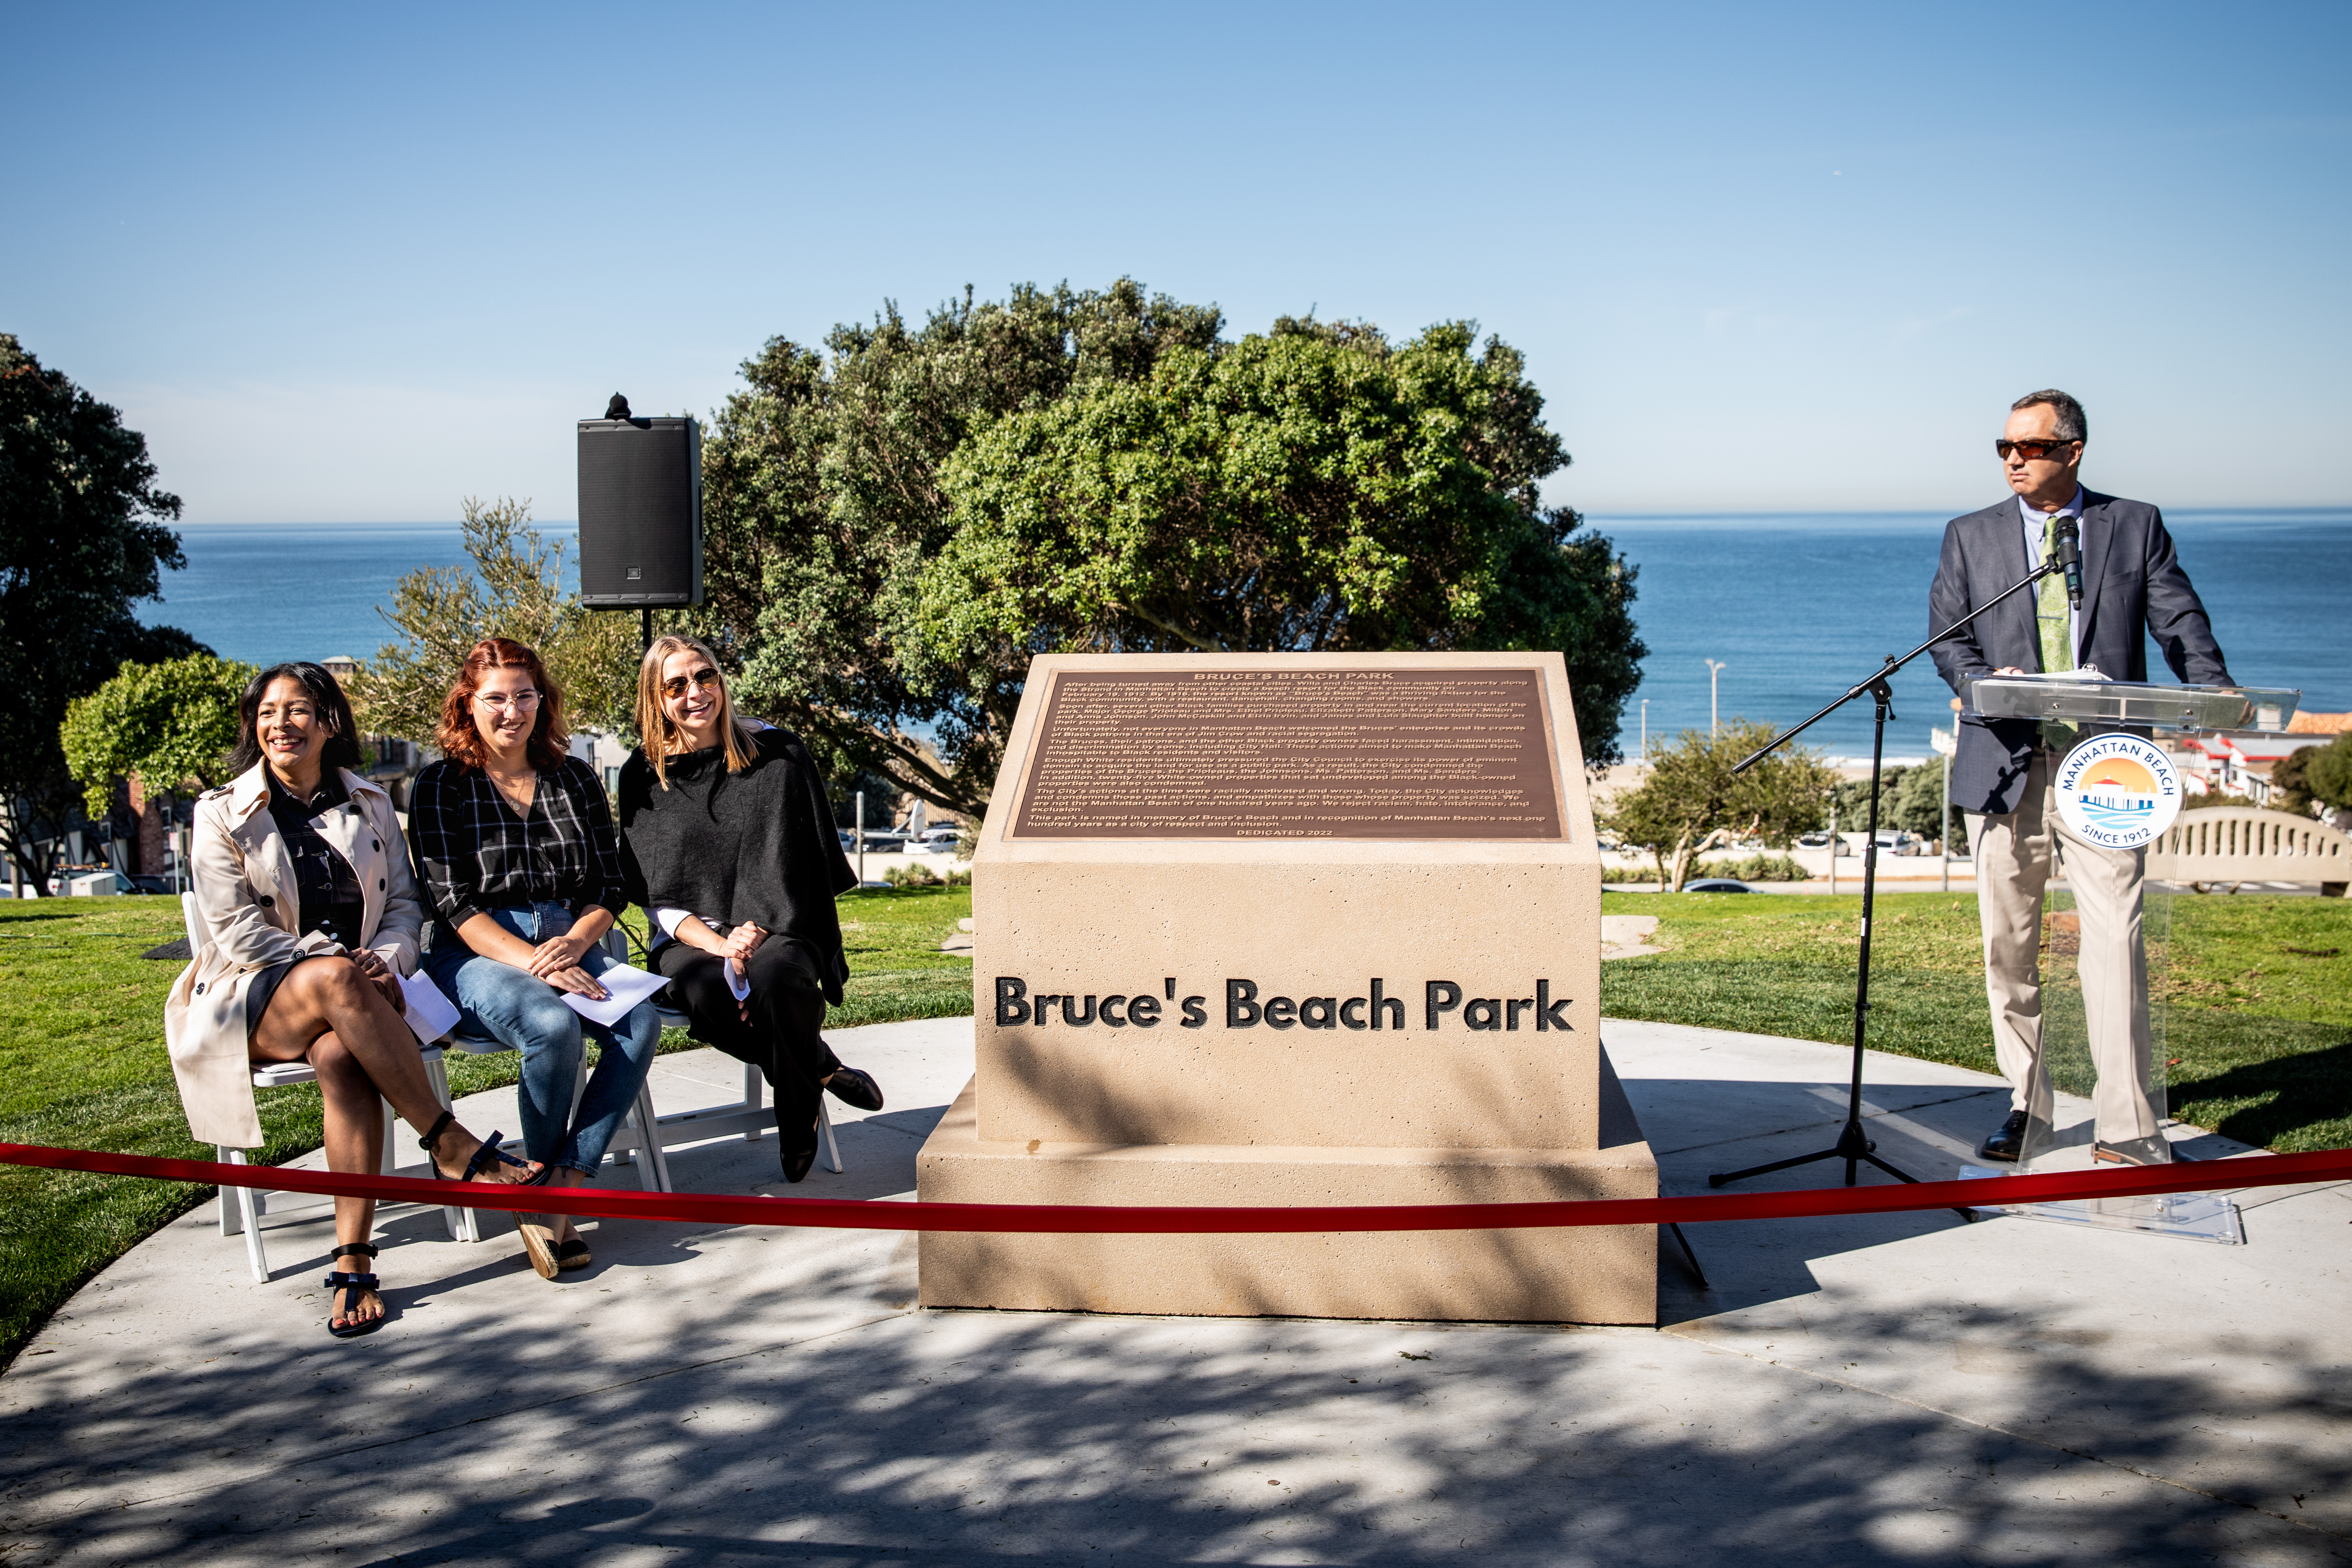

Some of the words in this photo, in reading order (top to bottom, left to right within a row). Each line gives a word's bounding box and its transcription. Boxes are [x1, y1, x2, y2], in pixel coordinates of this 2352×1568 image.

[2063, 742, 2141, 790] MANHATTAN
[2144, 752, 2174, 795] BEACH
[2082, 825, 2118, 844] SINCE
[2123, 828, 2151, 843] 1912
[994, 976, 1207, 1028] Bruce's
[1226, 978, 1405, 1030] Beach
[1425, 979, 1575, 1032] Park
